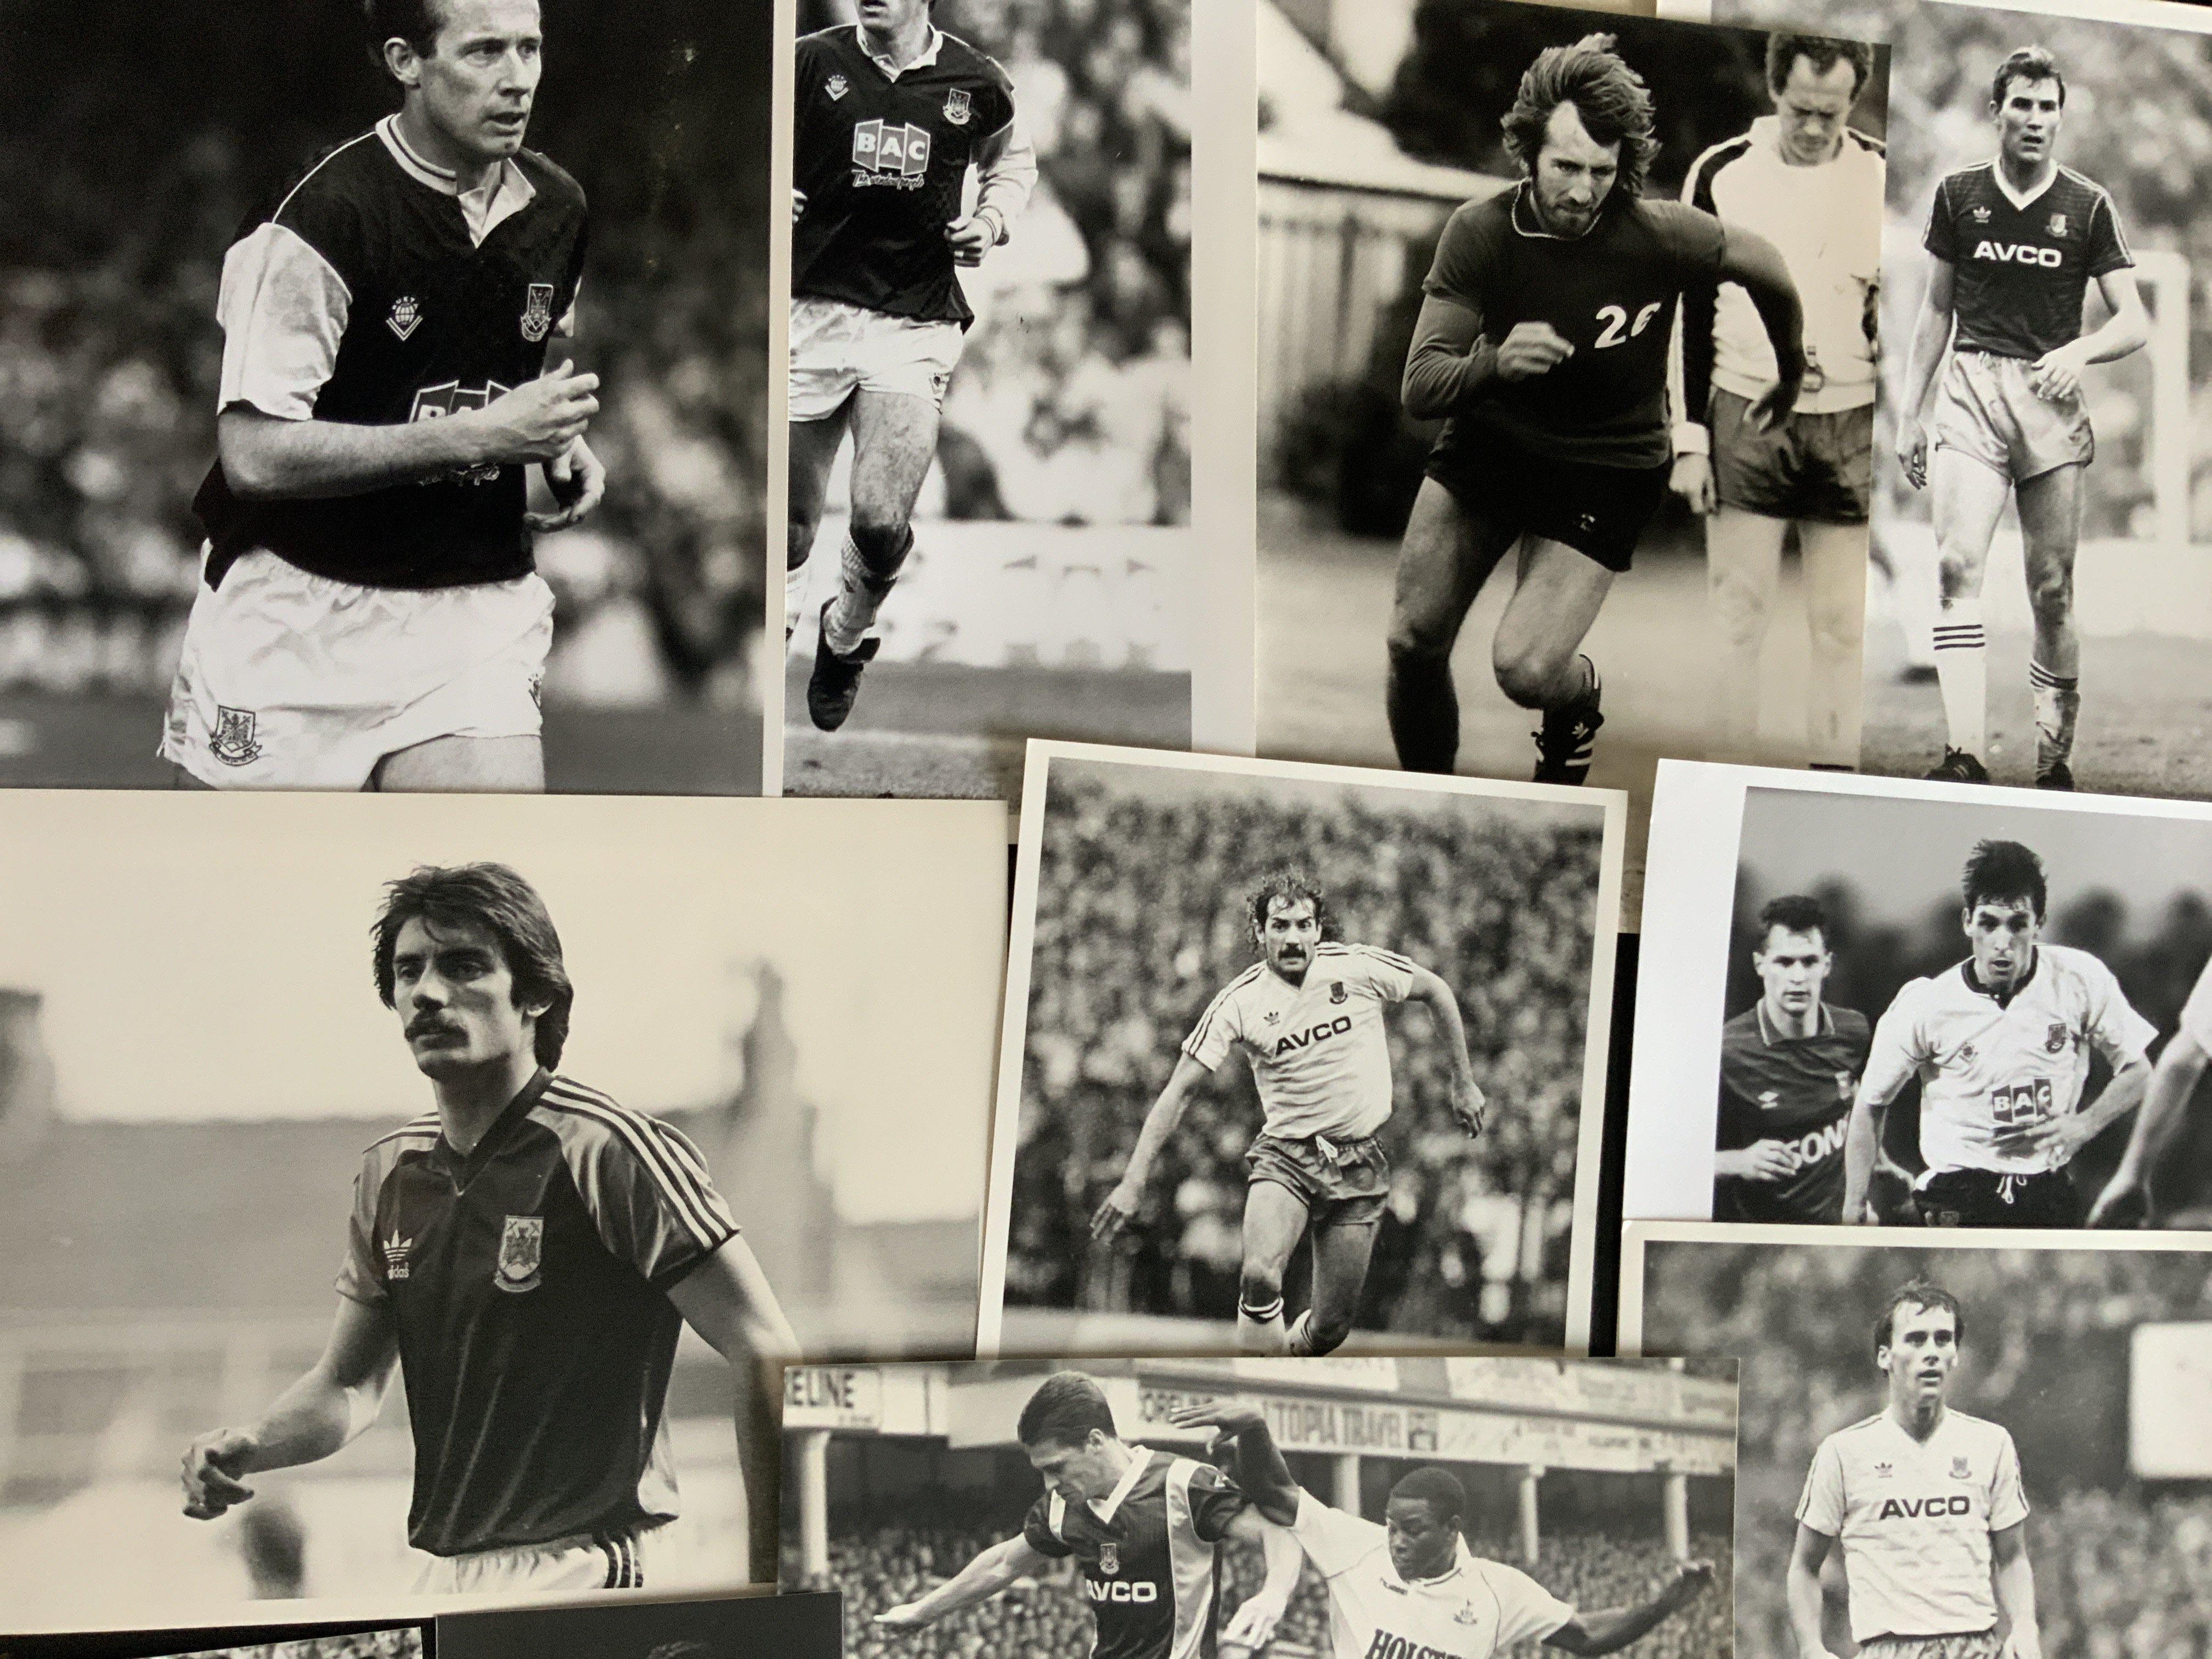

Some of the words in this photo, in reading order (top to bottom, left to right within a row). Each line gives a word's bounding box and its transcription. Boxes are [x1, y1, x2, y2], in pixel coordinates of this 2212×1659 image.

[856, 132, 926, 161] BAC
[1974, 240, 2062, 268] AVCO
[1276, 1015, 1352, 1056] AVCO
[1993, 1085, 2051, 1112] BAC
[787, 1369, 854, 1408] ELINE
[1879, 1496, 1970, 1520] AVCO
